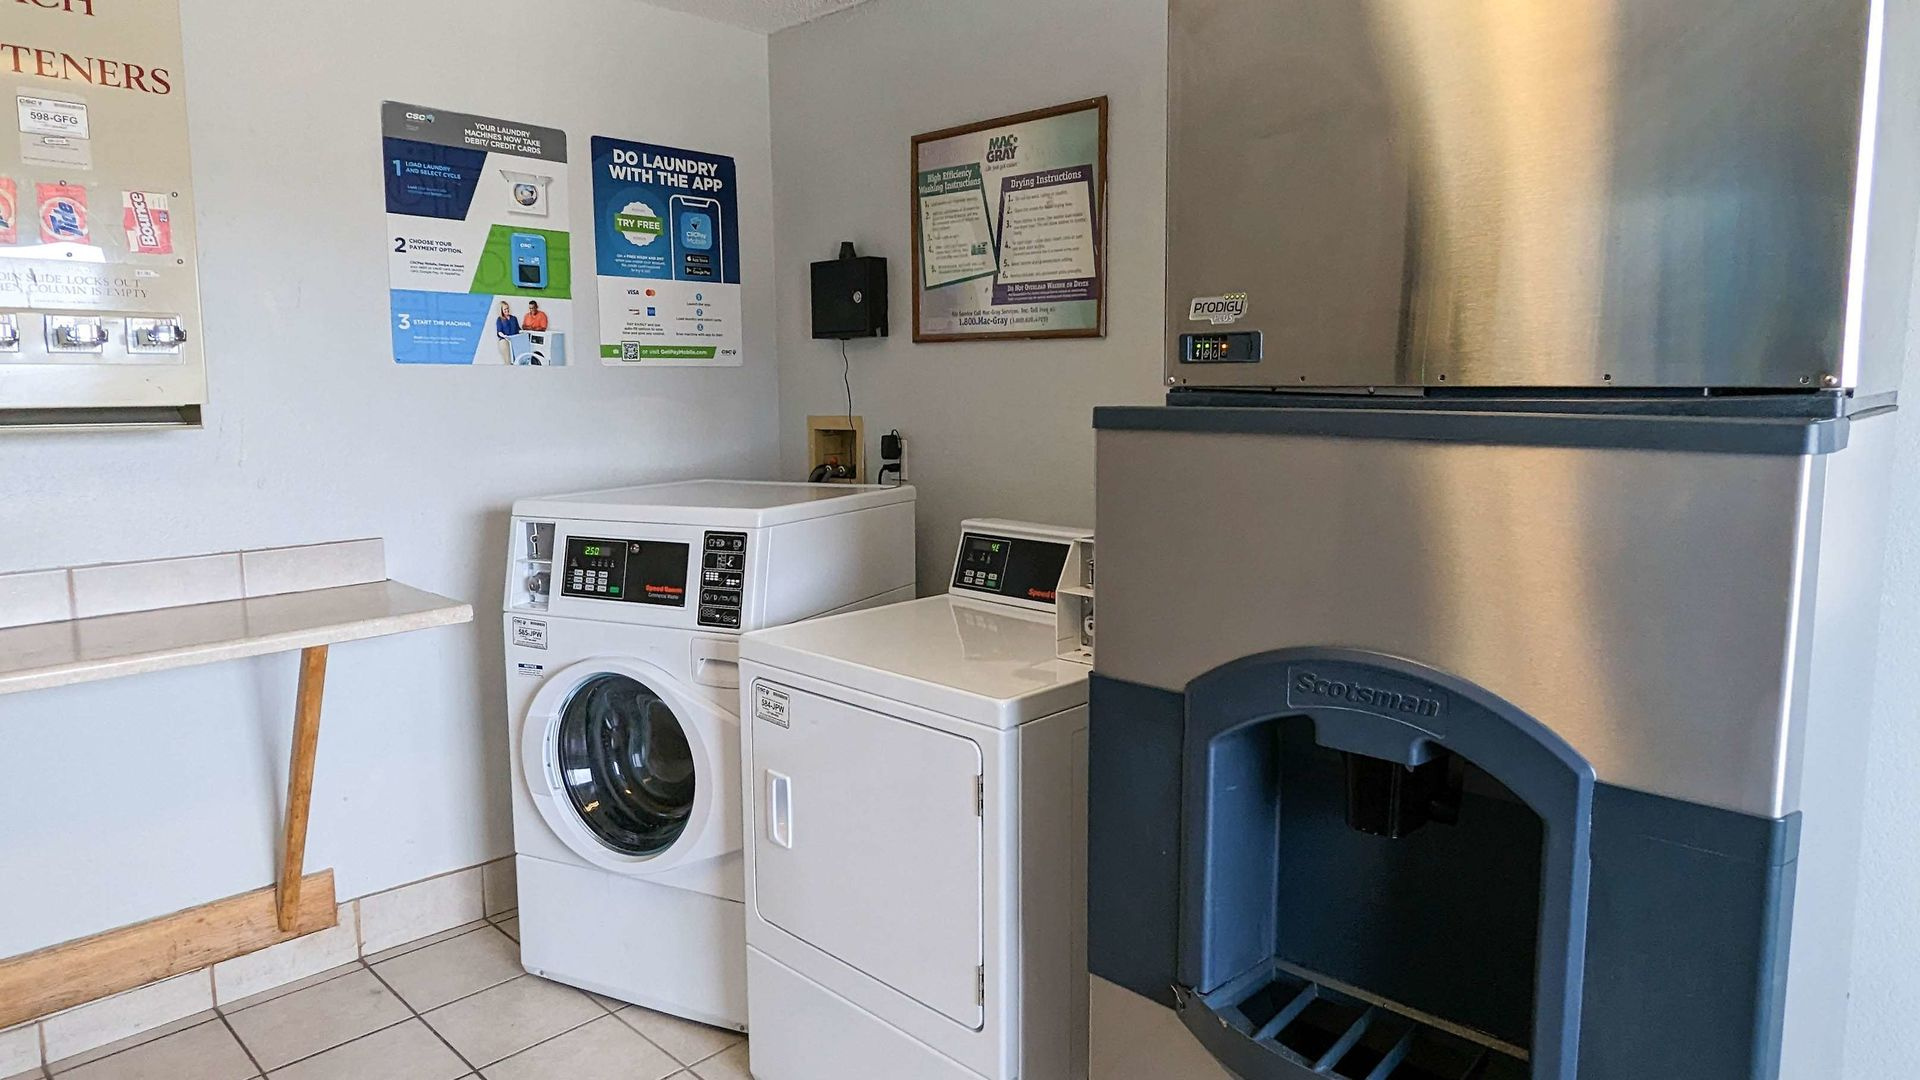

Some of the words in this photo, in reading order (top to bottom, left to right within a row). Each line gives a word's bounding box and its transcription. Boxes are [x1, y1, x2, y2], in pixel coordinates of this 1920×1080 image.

[30, 111, 78, 125] 598-GFG
[406, 112, 426, 120] CSC
[464, 128, 502, 140] MACHINES
[503, 135, 522, 144] NOW
[522, 138, 540, 147] TAKE
[474, 122, 496, 132] YOUR
[497, 126, 530, 138] LAUNDRY
[464, 136, 490, 146] DEBIT/
[490, 140, 516, 150] CREDIT
[517, 146, 541, 154] CARDS
[613, 148, 638, 166] DO
[642, 153, 718, 177] LAUNDRY
[986, 146, 1018, 163] GRAY
[393, 160, 401, 176] 1
[423, 164, 450, 172] LAUNDRY
[927, 172, 941, 184] High
[942, 168, 972, 181] Efficiency
[608, 164, 653, 184] WITH
[657, 171, 689, 188] THE
[692, 176, 723, 193] APP
[944, 177, 981, 190] Instructions
[1010, 177, 1035, 189] Drying
[1036, 170, 1082, 184] Instructions
[49, 201, 84, 236] Tide
[130, 192, 158, 246] Bounce
[616, 218, 635, 228] TRY
[637, 220, 660, 230] FREE
[394, 237, 406, 253] 2
[66, 274, 110, 287] LOCKS
[114, 279, 140, 288] OUT
[28, 284, 87, 296] COLUMN
[92, 287, 101, 296] IS
[106, 288, 147, 298] EMPTY
[398, 314, 410, 330] 3
[1213, 314, 1233, 322] PLUS
[1297, 672, 1440, 717] Scotsman
